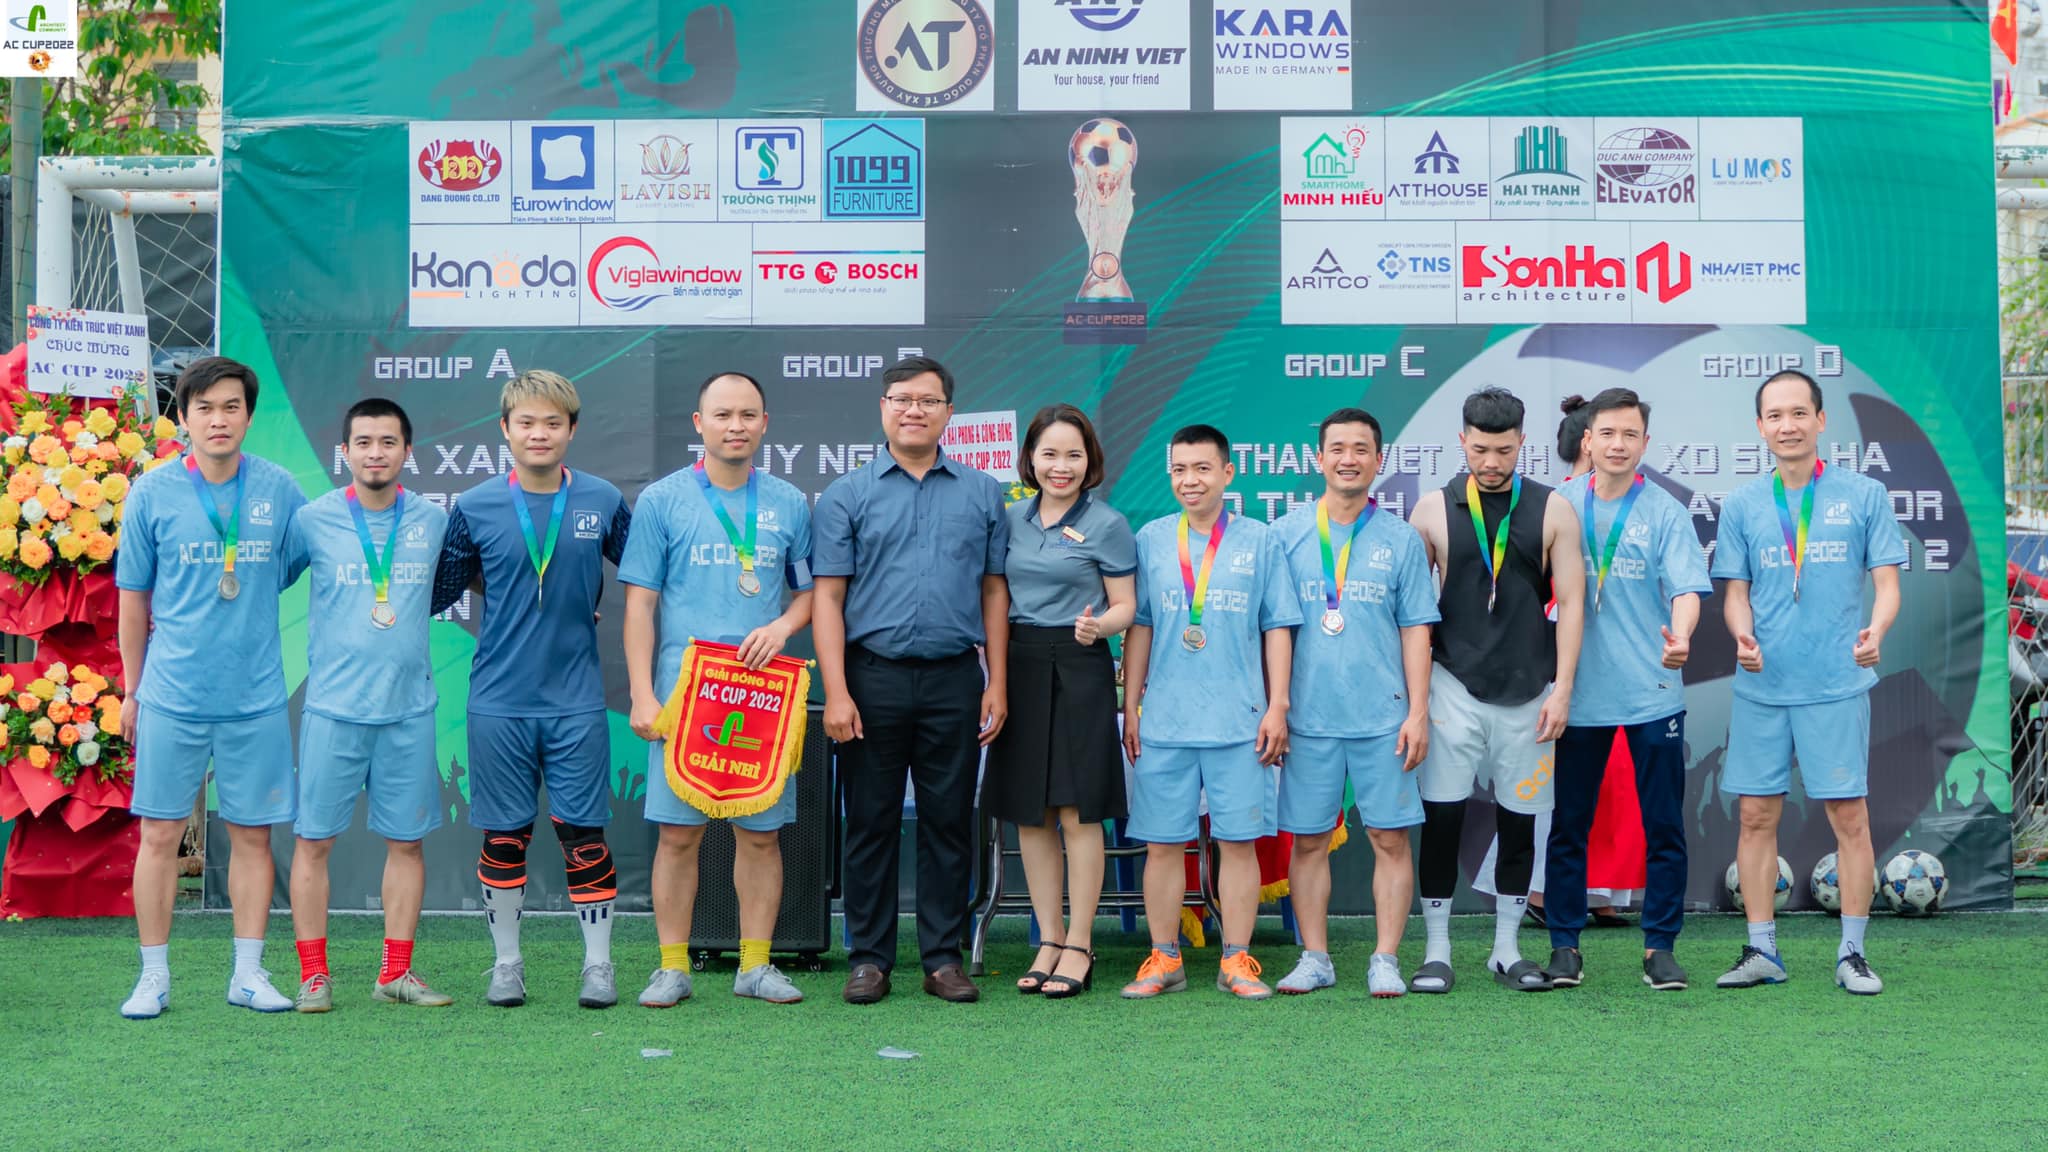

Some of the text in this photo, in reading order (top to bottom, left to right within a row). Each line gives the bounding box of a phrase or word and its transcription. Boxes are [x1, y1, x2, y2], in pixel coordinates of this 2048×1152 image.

[1215, 9, 1349, 36] KARA
[1024, 48, 1187, 65] AN NINH VIET
[1215, 43, 1350, 59] WINDOWS
[1054, 73, 1159, 87] Your house, your friend
[1215, 66, 1333, 75] MADE IN GERMANY
[1597, 153, 1695, 162] DUC ANH COMPANY
[834, 156, 911, 184] 1099
[620, 184, 711, 200] LAVISH
[1283, 188, 1383, 205] MINH HIẾU
[1388, 184, 1488, 197] ATTHOUSE
[1503, 185, 1580, 196] HAI THANH
[1596, 172, 1695, 203] ELEVATOR
[421, 194, 442, 202] DANG
[444, 194, 471, 202] DUONG
[512, 196, 614, 212] Eurowindow
[777, 195, 816, 207] THỊNH
[833, 192, 913, 211] FURNITURE
[412, 250, 577, 288] Kanada
[758, 264, 805, 280] TTG
[848, 263, 918, 279] BOSCH
[1408, 257, 1451, 272] TNS
[1768, 263, 1801, 275] PMC
[608, 265, 742, 288] Viglawindow
[1286, 276, 1369, 289] ARITCO
[465, 290, 577, 298] LIGHTING
[728, 288, 743, 298] gian
[1463, 290, 1626, 301] architecture
[54, 318, 64, 330] TY
[124, 324, 146, 337] XANH
[1065, 315, 1145, 324] AC CUP2022
[374, 348, 516, 379] GROUP A
[782, 356, 883, 378] GROUP
[1284, 346, 1425, 377] GROUP C
[1702, 345, 1844, 378] GROUP D
[32, 362, 145, 382] AC CUP 2022
[976, 451, 990, 470] CUP
[992, 450, 1012, 469] 2022
[179, 542, 201, 565] AC
[689, 544, 711, 566] AC
[1760, 546, 1778, 569] AC
[335, 564, 358, 585] AC
[1161, 590, 1178, 613] AC
[705, 666, 784, 692] GIẢI BÓNG ĐÁ
[699, 682, 782, 713] AC CUP 2022
[689, 752, 761, 780] GIẢI NHÌ
